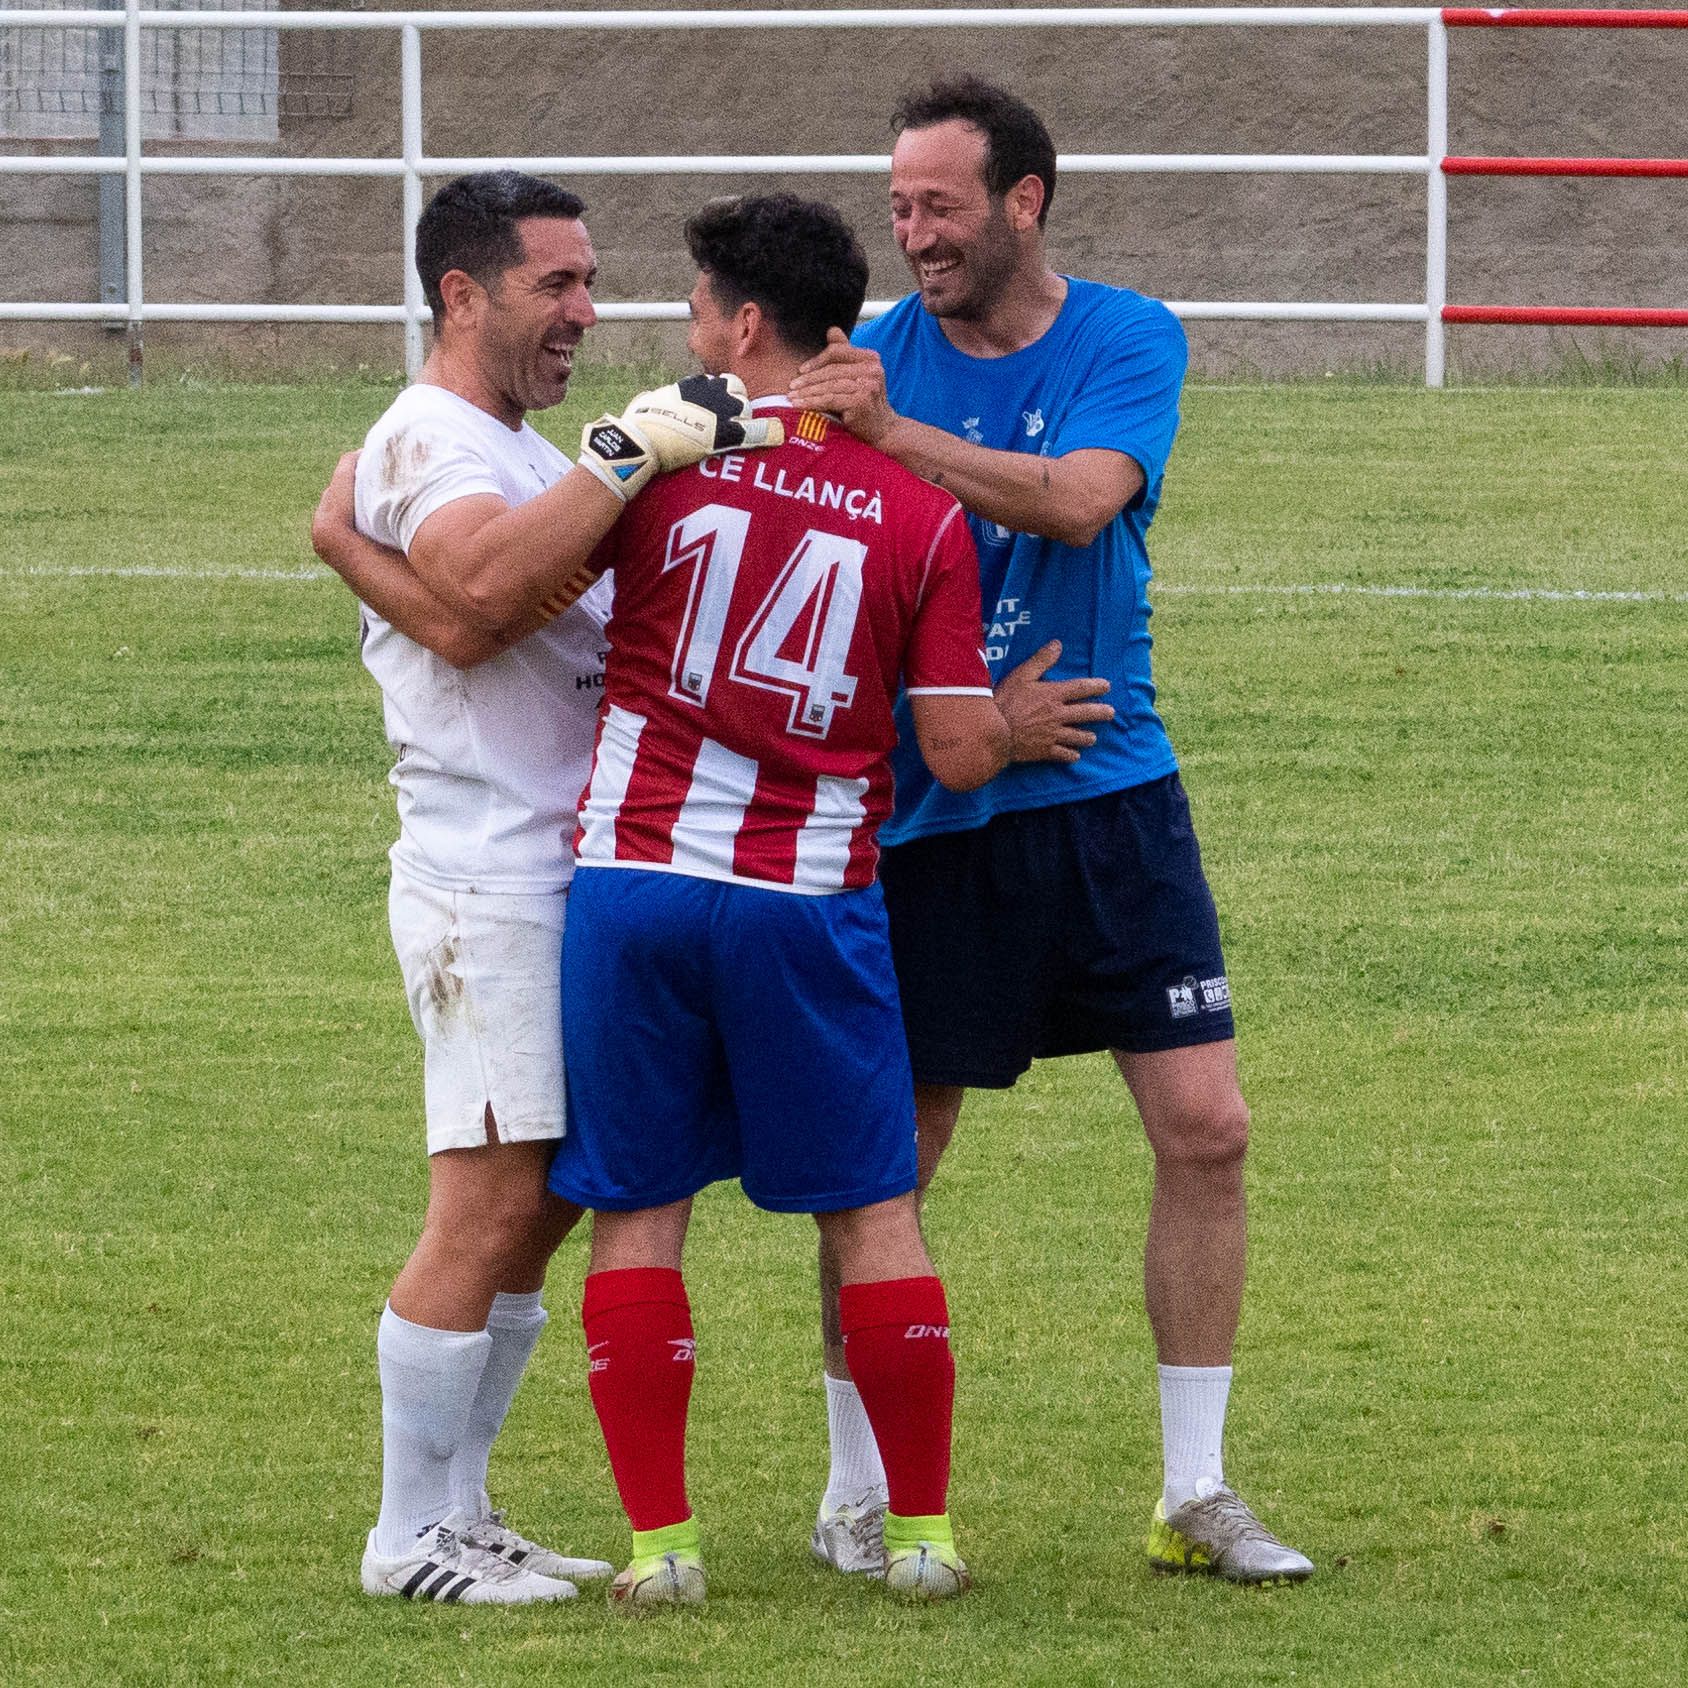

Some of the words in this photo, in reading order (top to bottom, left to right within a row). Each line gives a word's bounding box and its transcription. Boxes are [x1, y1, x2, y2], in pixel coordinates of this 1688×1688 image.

[650, 407, 705, 432] SELLS
[788, 436, 826, 453] ONZE
[699, 454, 745, 482] CE
[753, 461, 882, 525] LLANÇÀ
[661, 503, 869, 740] 14
